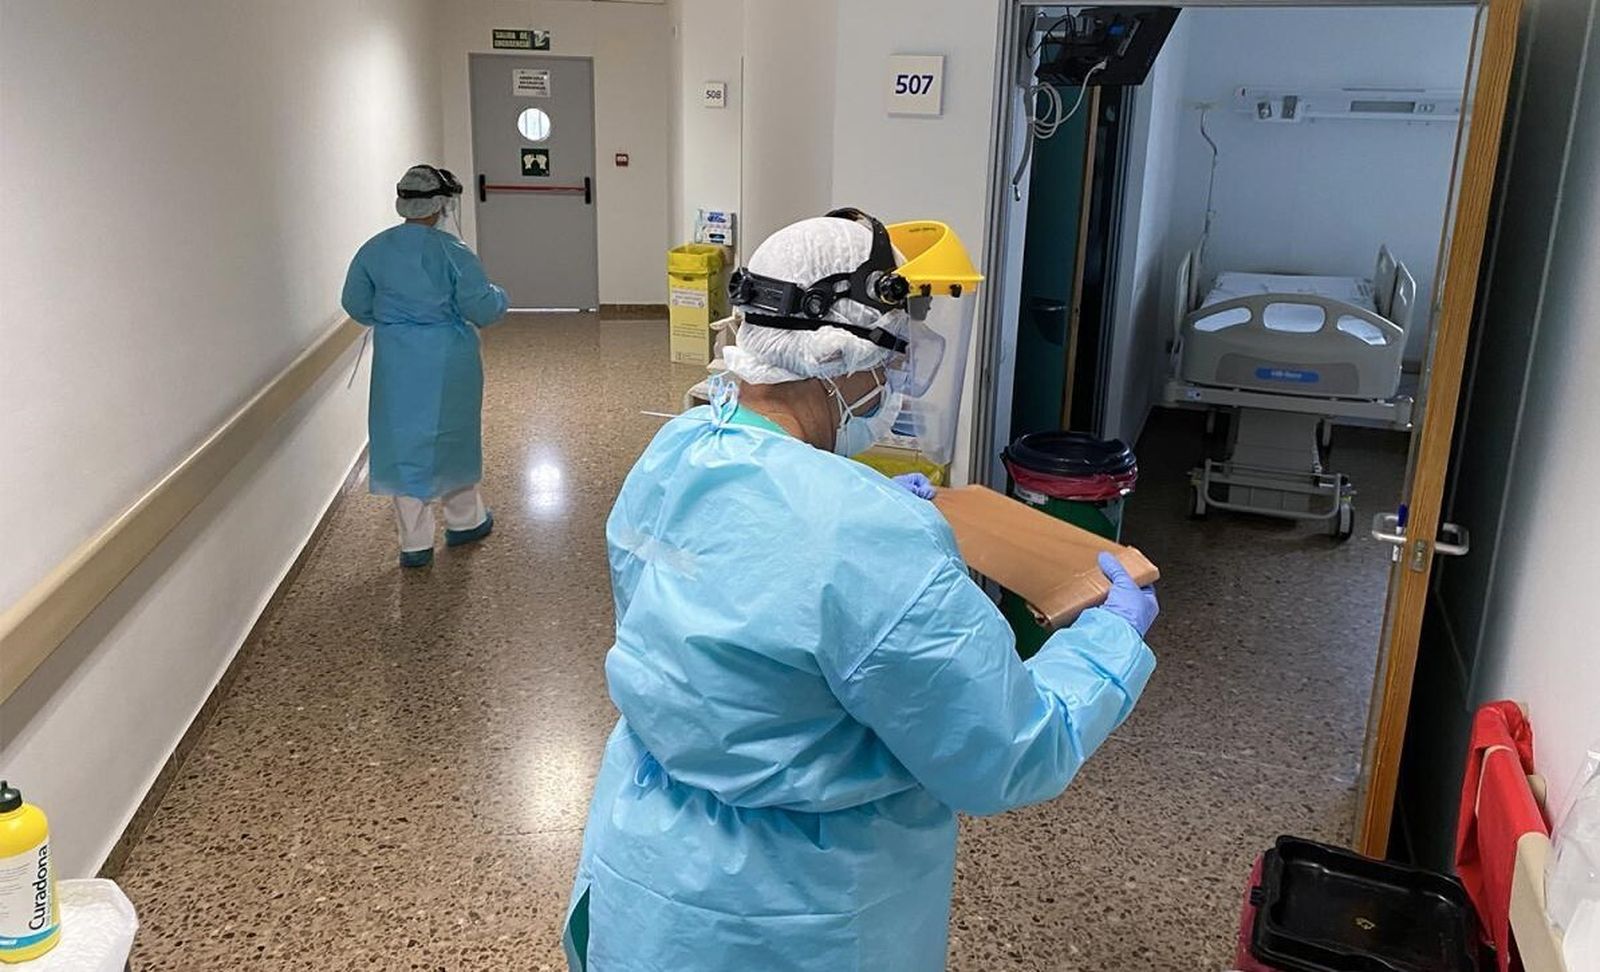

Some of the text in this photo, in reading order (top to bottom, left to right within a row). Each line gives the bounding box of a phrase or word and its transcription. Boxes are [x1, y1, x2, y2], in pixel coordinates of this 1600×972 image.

[705, 89, 722, 100] 508
[894, 74, 934, 96] 507
[28, 845, 48, 930] Curadona
